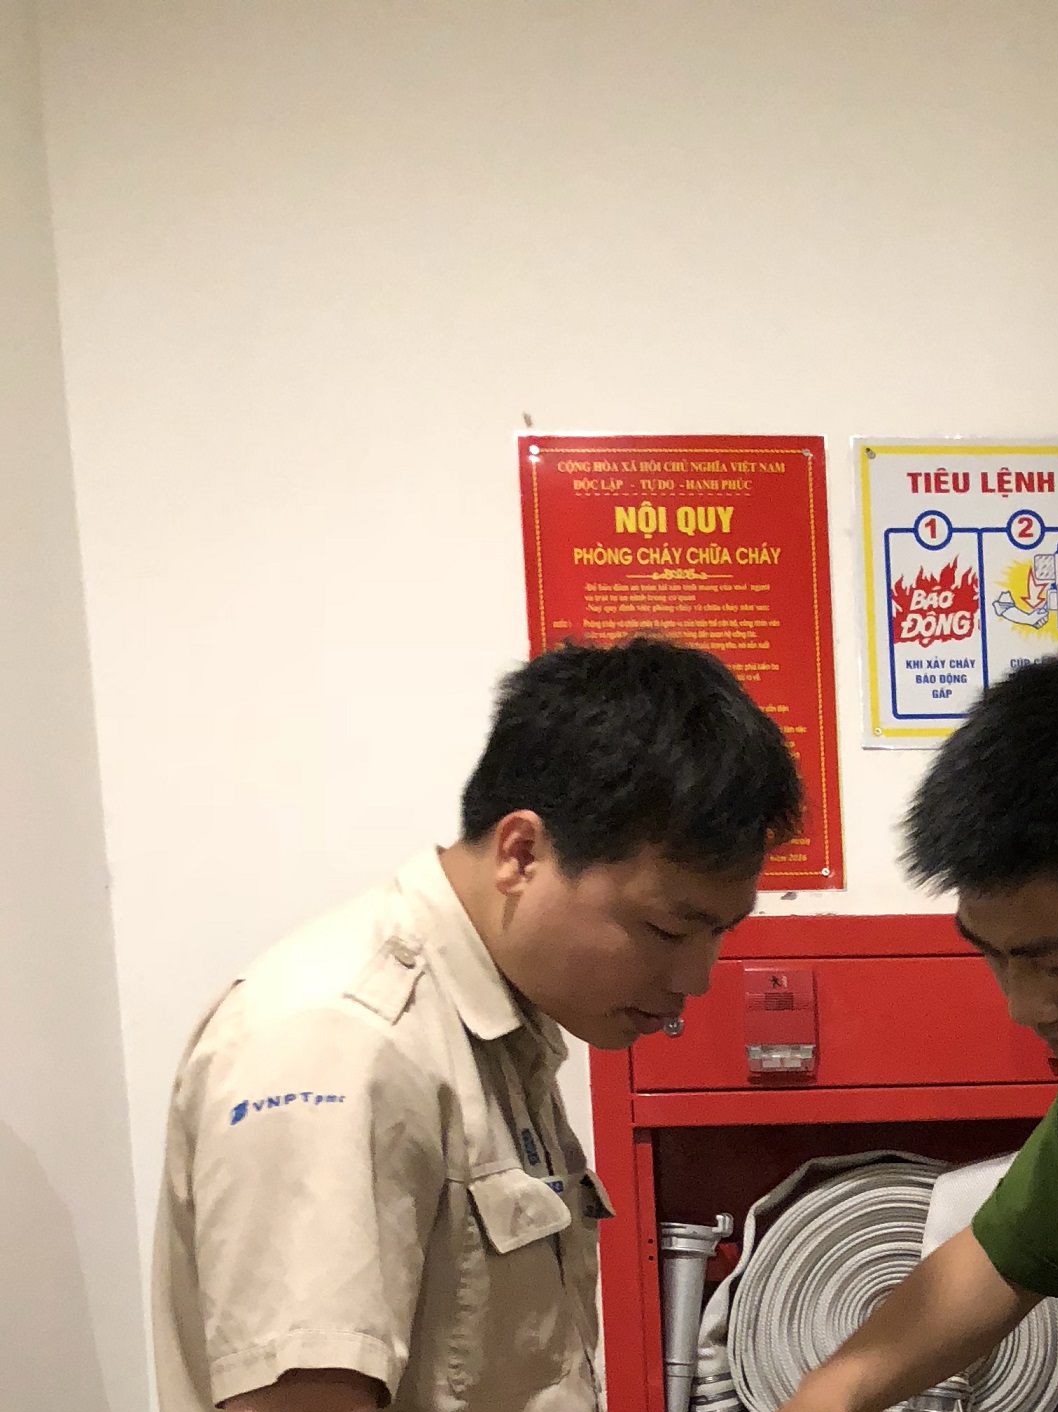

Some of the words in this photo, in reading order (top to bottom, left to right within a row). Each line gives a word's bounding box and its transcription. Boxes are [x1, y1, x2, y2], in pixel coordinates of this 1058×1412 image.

[557, 460, 591, 474] CỘNG
[593, 459, 619, 472] HÒA
[621, 459, 638, 472] XÃ
[640, 459, 661, 473] HỘI
[663, 459, 688, 472] CHỦ
[690, 460, 727, 472] NGHĨA
[730, 460, 757, 473] VIỆT
[760, 462, 785, 473] NAM
[573, 477, 598, 491] ĐỘC
[601, 477, 623, 491] LẬP
[640, 479, 656, 491] TỰ
[658, 480, 674, 490] DO
[721, 477, 752, 490] PHÚC
[906, 467, 970, 493] TIÊU
[981, 467, 1055, 498] LỆNH
[614, 500, 667, 539] NỘI
[676, 506, 734, 536] QUY
[924, 518, 937, 540] 1
[1017, 517, 1034, 538] 2
[573, 542, 633, 565] PHÒNG
[636, 542, 682, 565] CHÁY
[686, 543, 732, 565] CHỮA
[735, 542, 781, 565] CHÁY
[909, 586, 955, 611] BÁO
[900, 611, 971, 643] ĐỘNG
[905, 659, 923, 669] KHI
[926, 656, 946, 669] XẢY
[949, 657, 976, 669] CHÁY
[915, 672, 936, 684] BÁO
[939, 673, 968, 685] ĐỘNG
